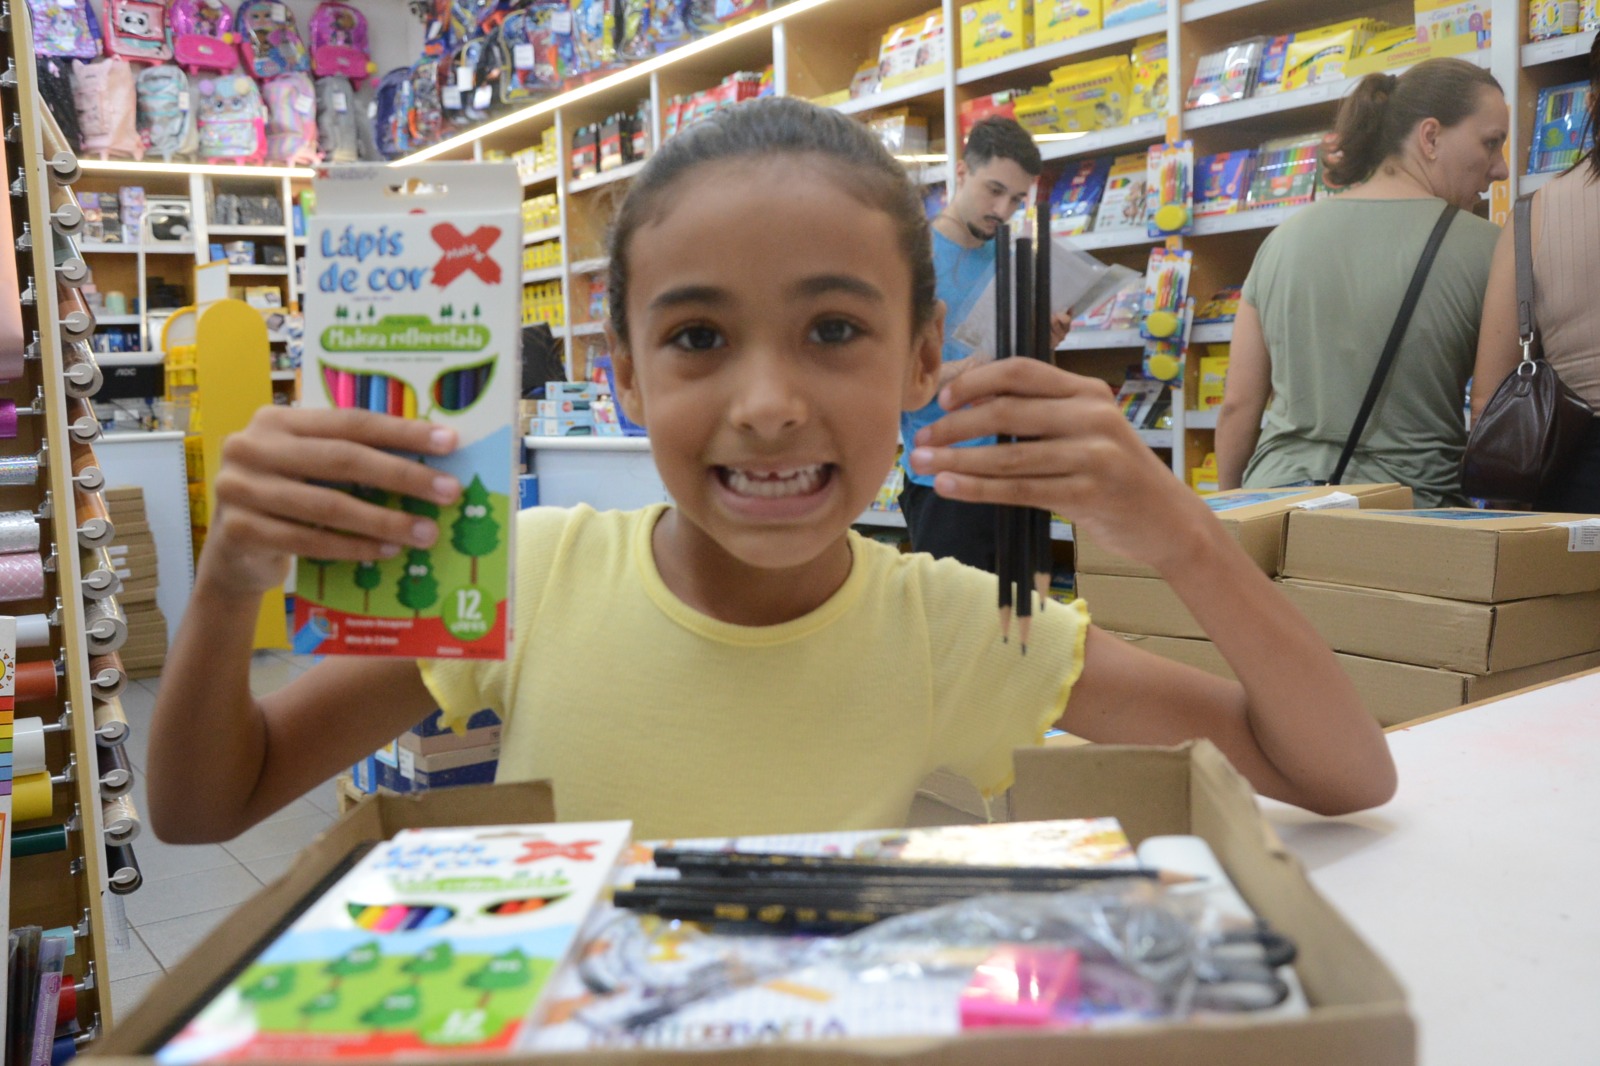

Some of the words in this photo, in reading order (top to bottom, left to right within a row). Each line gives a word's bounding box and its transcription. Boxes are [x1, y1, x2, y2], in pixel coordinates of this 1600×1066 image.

[321, 224, 404, 262] Lápis
[319, 263, 359, 292] de
[367, 265, 427, 291] cor
[457, 588, 482, 619] 12
